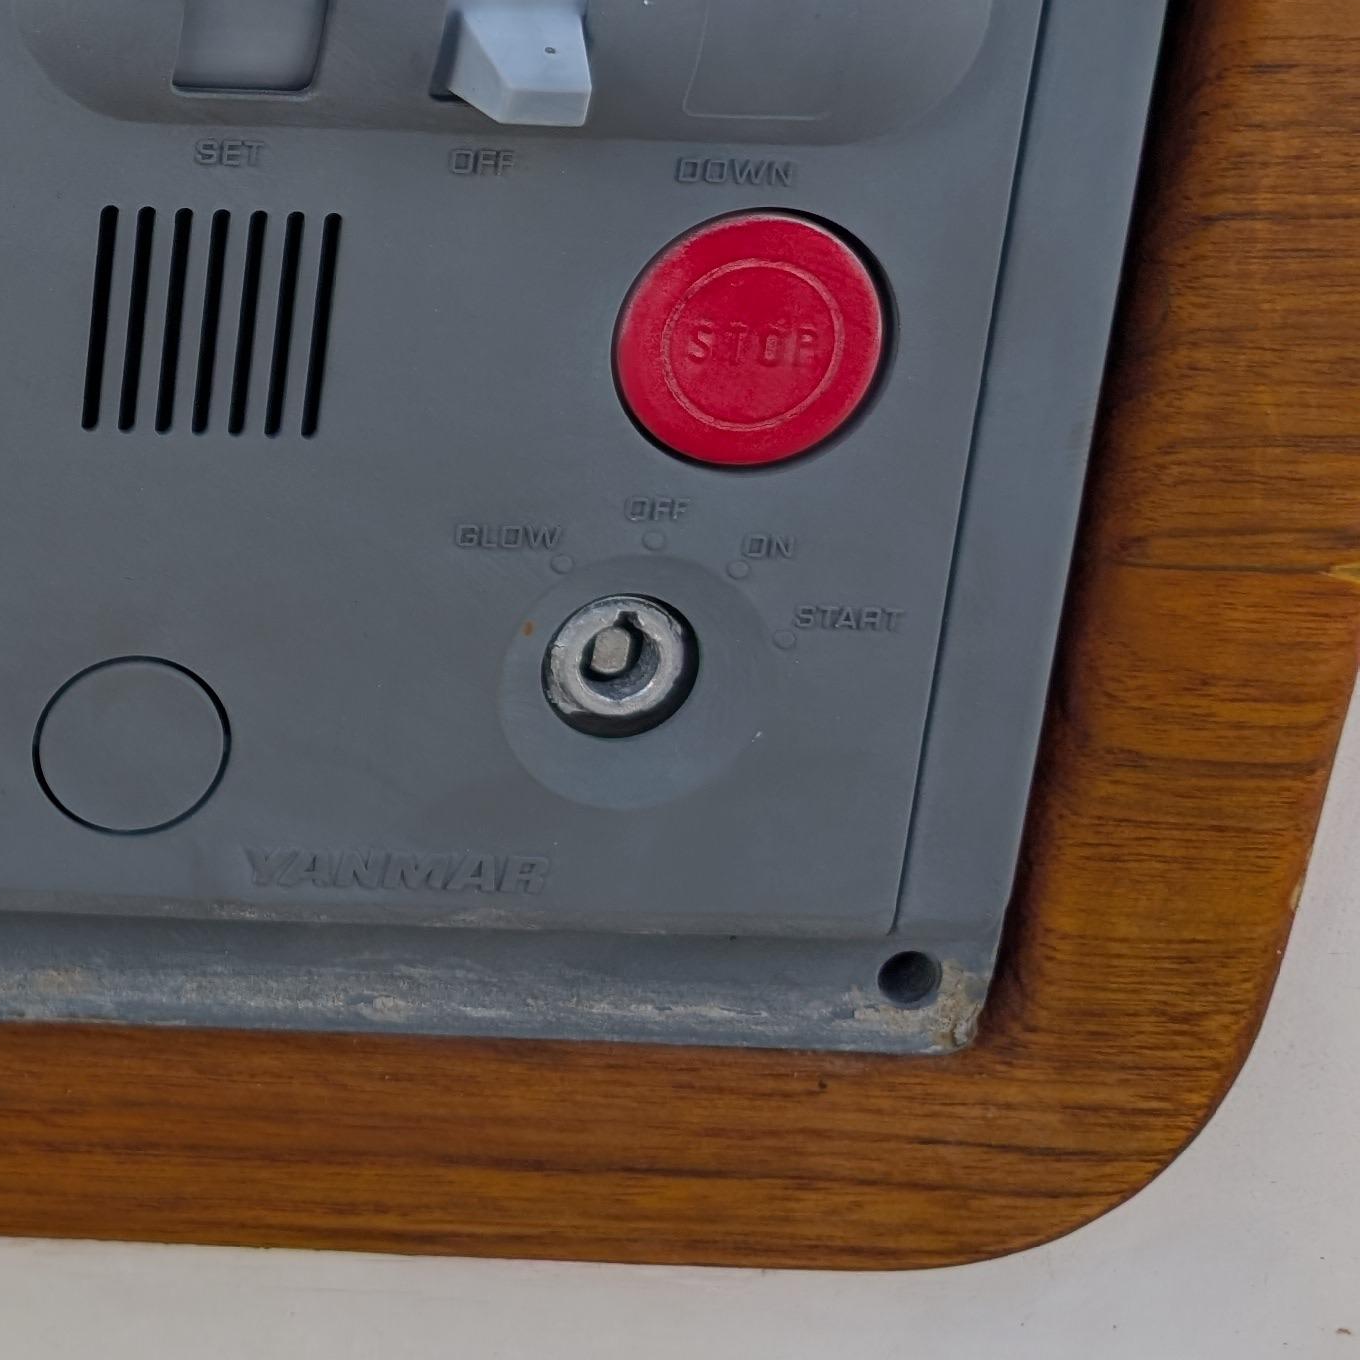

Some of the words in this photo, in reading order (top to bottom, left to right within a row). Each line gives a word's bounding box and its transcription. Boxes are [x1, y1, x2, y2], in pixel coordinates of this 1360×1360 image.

[194, 139, 265, 167] SET
[449, 148, 516, 176] OFF
[677, 159, 793, 187] DOWN
[687, 319, 818, 367] STOP
[624, 497, 689, 522] OFF
[455, 524, 562, 551] GLOW
[741, 534, 796, 560] ON
[794, 605, 905, 632] START
[246, 845, 550, 894] YANMAR
